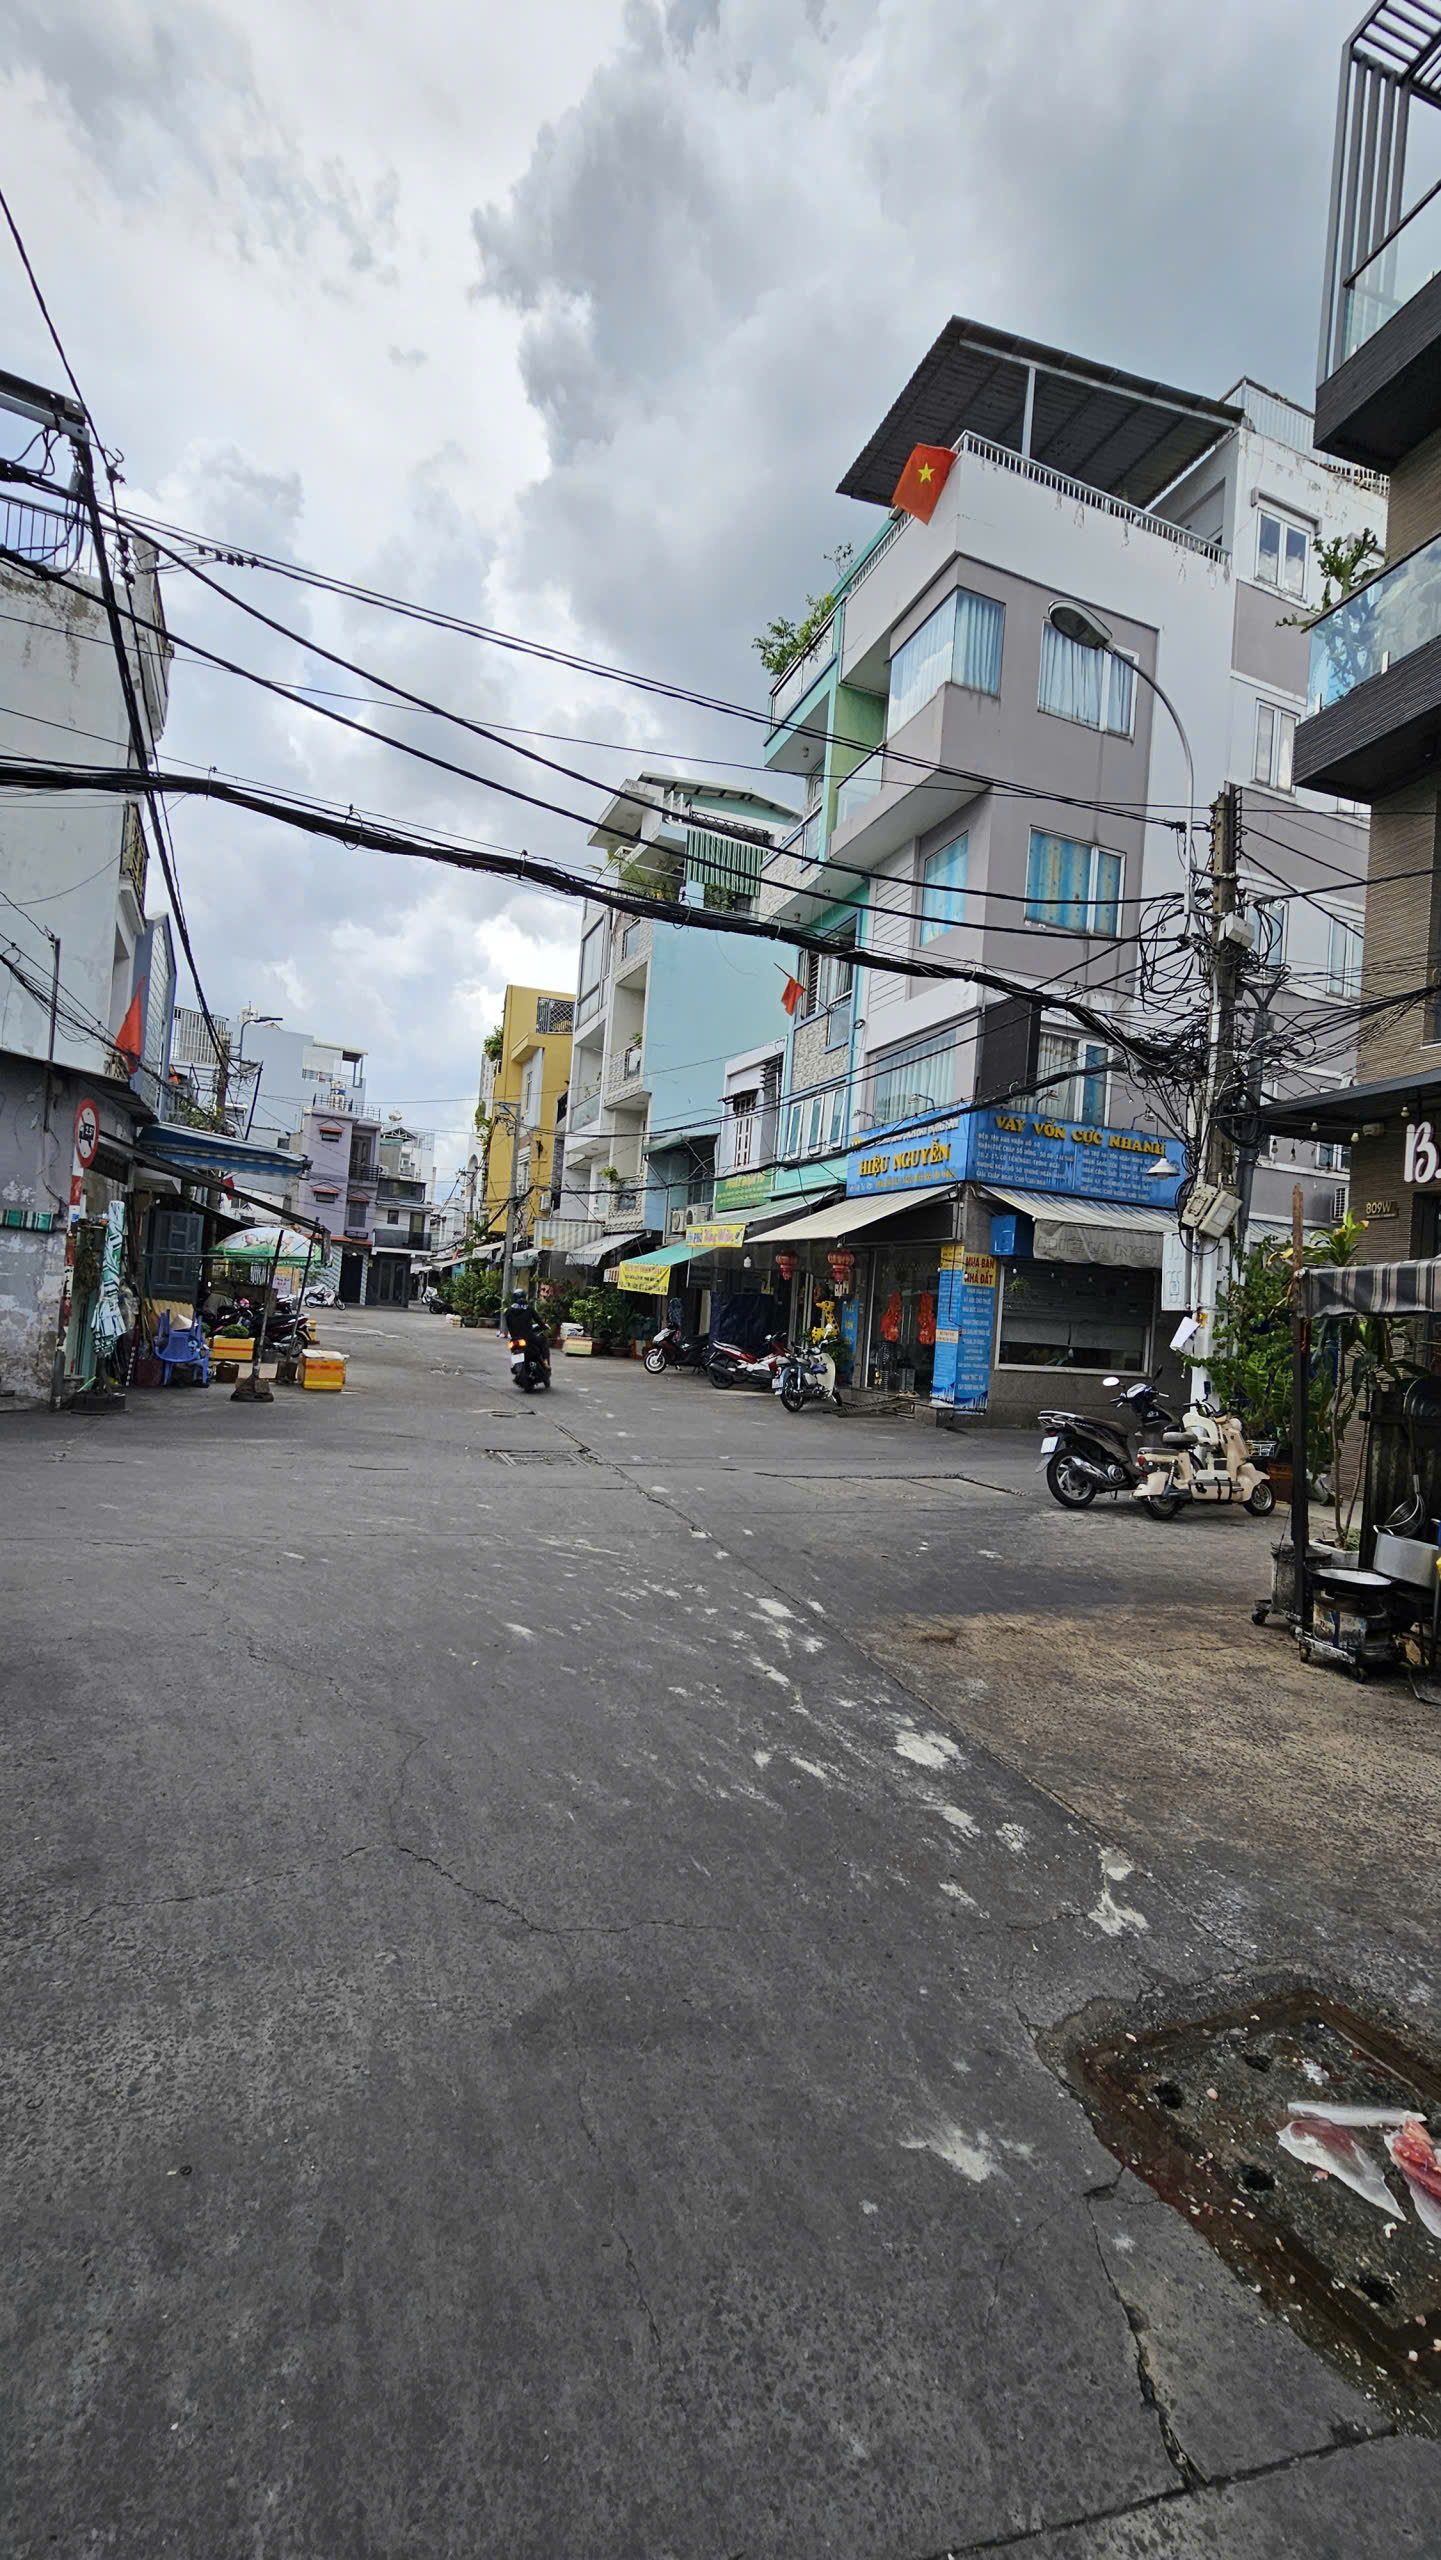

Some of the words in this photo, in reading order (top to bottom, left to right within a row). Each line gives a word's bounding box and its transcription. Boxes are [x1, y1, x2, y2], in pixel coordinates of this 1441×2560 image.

[995, 1116, 1027, 1134] VAY
[1033, 1120, 1066, 1140] VỐN
[1072, 1129, 1103, 1147] CỰC
[1108, 1136, 1167, 1155] NHANH
[859, 1155, 890, 1177] HIỆU
[893, 1139, 951, 1171] NGUYỄN
[1366, 1200, 1392, 1215] 809W
[980, 1269, 993, 1285] ĐẤT
